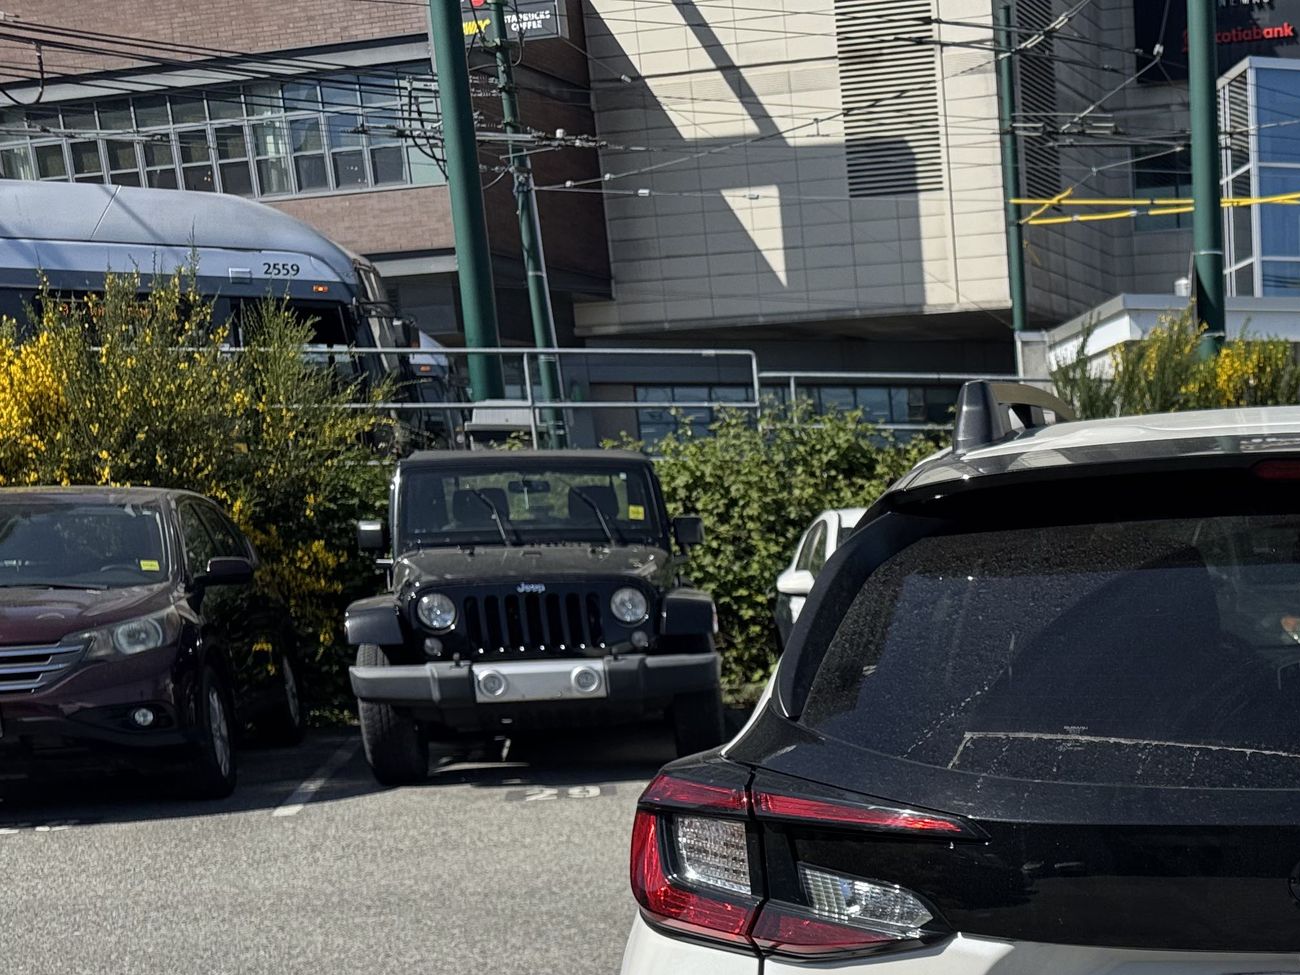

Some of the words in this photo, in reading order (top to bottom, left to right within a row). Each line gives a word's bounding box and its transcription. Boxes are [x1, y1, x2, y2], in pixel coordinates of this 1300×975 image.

[463, 17, 491, 36] WAY
[1216, 22, 1294, 43] cotiabank
[262, 262, 301, 277] 2559
[516, 582, 546, 594] Jeep
